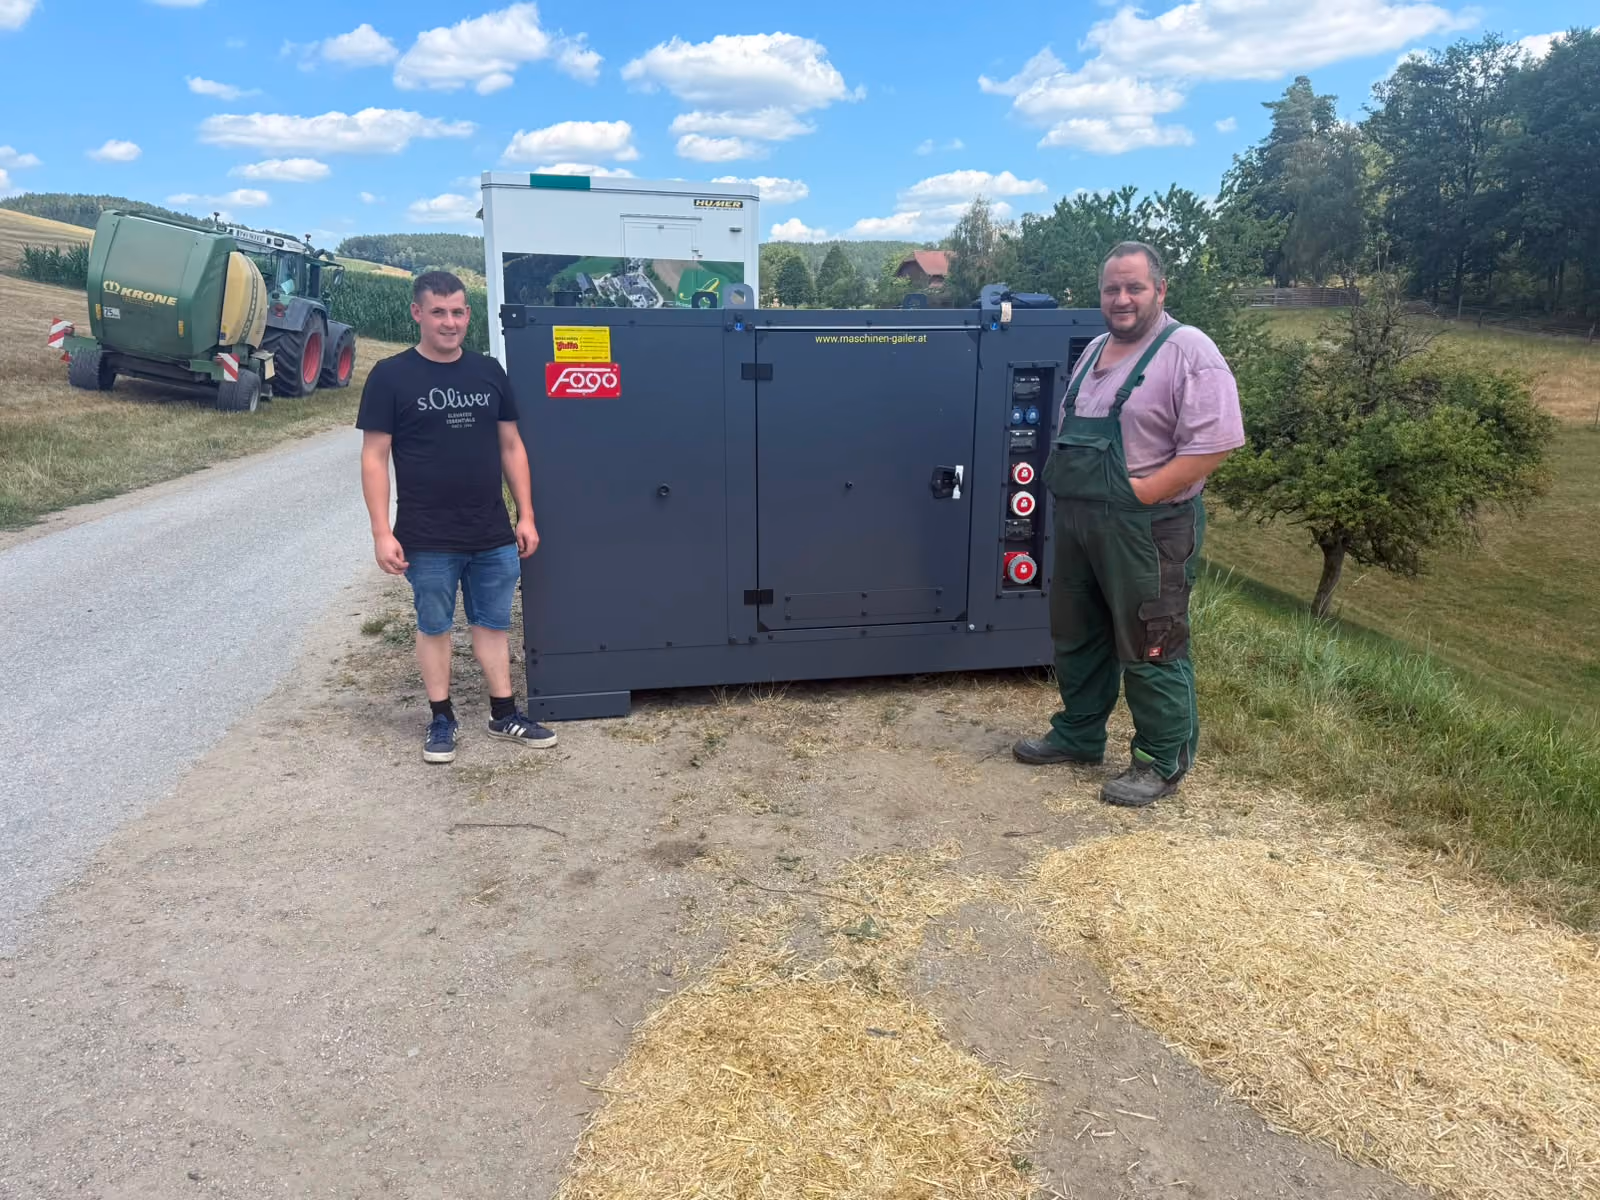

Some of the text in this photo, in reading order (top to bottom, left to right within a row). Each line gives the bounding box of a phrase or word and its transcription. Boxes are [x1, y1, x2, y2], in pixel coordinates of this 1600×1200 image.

[695, 200, 742, 208] HUMER
[120, 287, 178, 306] KRONE
[815, 333, 927, 345] www.maschinen-gailer.at
[417, 387, 491, 411] s.Oliver
